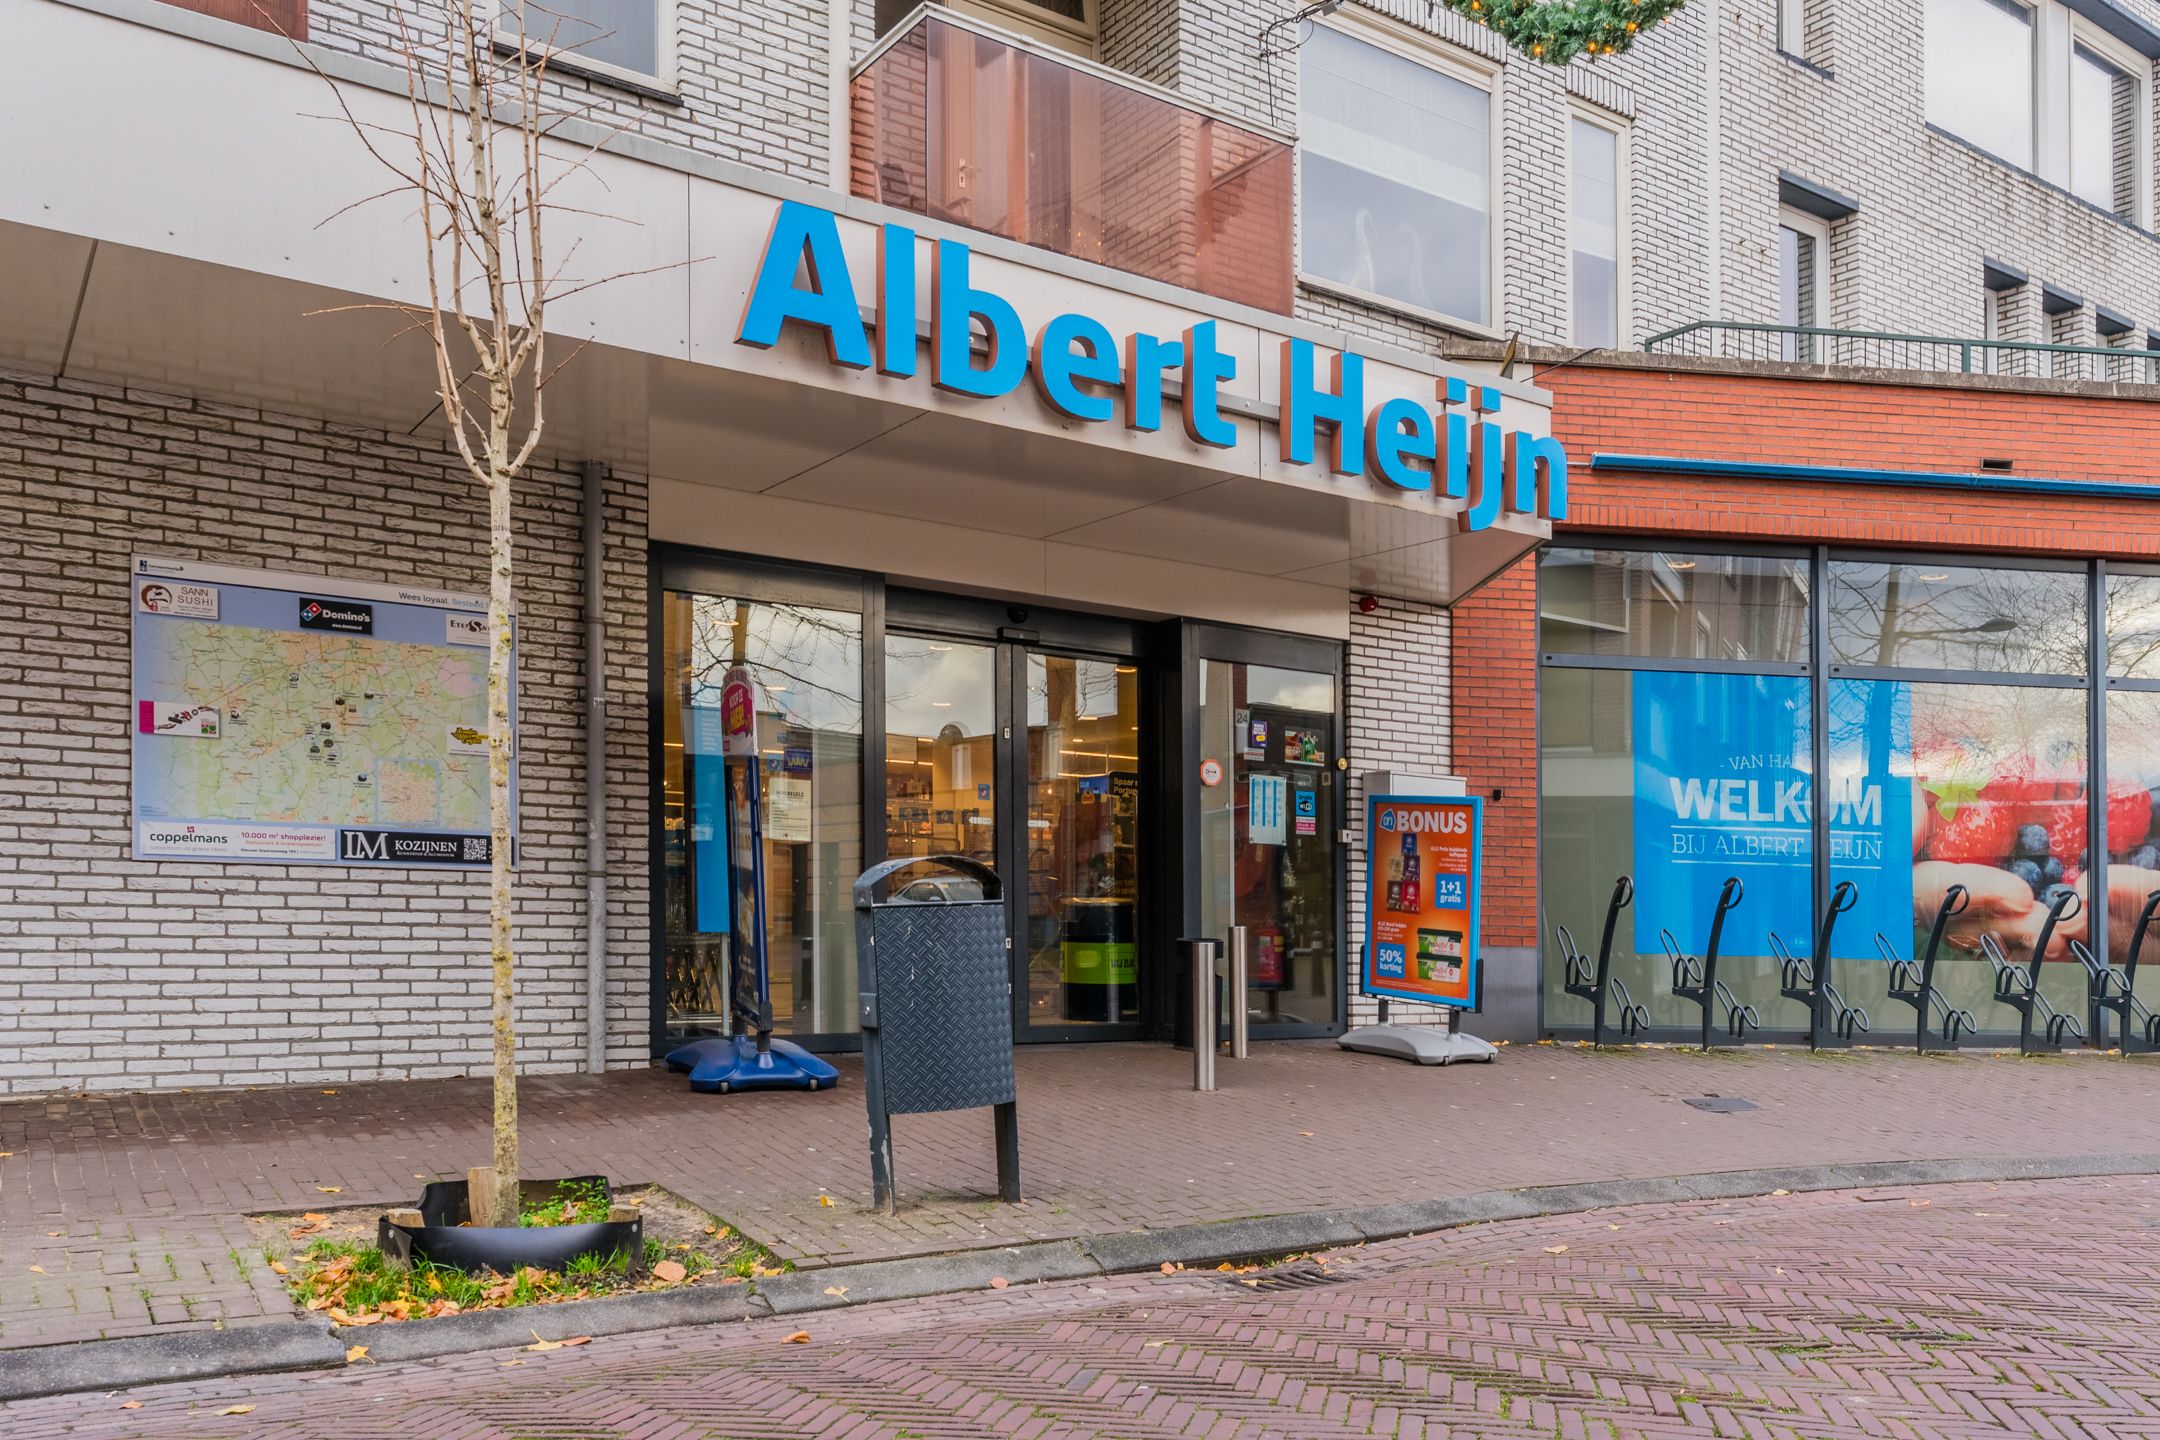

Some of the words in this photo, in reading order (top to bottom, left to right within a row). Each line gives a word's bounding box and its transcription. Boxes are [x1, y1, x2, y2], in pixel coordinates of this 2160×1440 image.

[733, 198, 1238, 450] Albert
[1279, 336, 1568, 532] Heijn
[181, 586, 208, 597] SANN
[177, 595, 213, 606] SUSHI
[399, 591, 420, 602] Wees
[452, 598, 483, 608] Besteed
[322, 609, 370, 622] Domino's
[1236, 712, 1248, 723] 24
[1728, 754, 1764, 770] VAN
[1669, 777, 1883, 826] WELKOM
[1396, 810, 1468, 834] BONUS
[149, 831, 228, 845] coppelmans
[240, 832, 267, 840] 10.000
[280, 833, 326, 842] shopplezier!
[394, 839, 457, 853] KOZIJNEN
[1671, 833, 1706, 854] BIJ
[1714, 835, 1805, 857] ALBERT
[1828, 839, 1883, 860] EIJN
[1440, 879, 1462, 895] 1+1
[1439, 894, 1462, 904] gratis
[1379, 948, 1403, 964] 50%
[1379, 962, 1402, 974] korting
